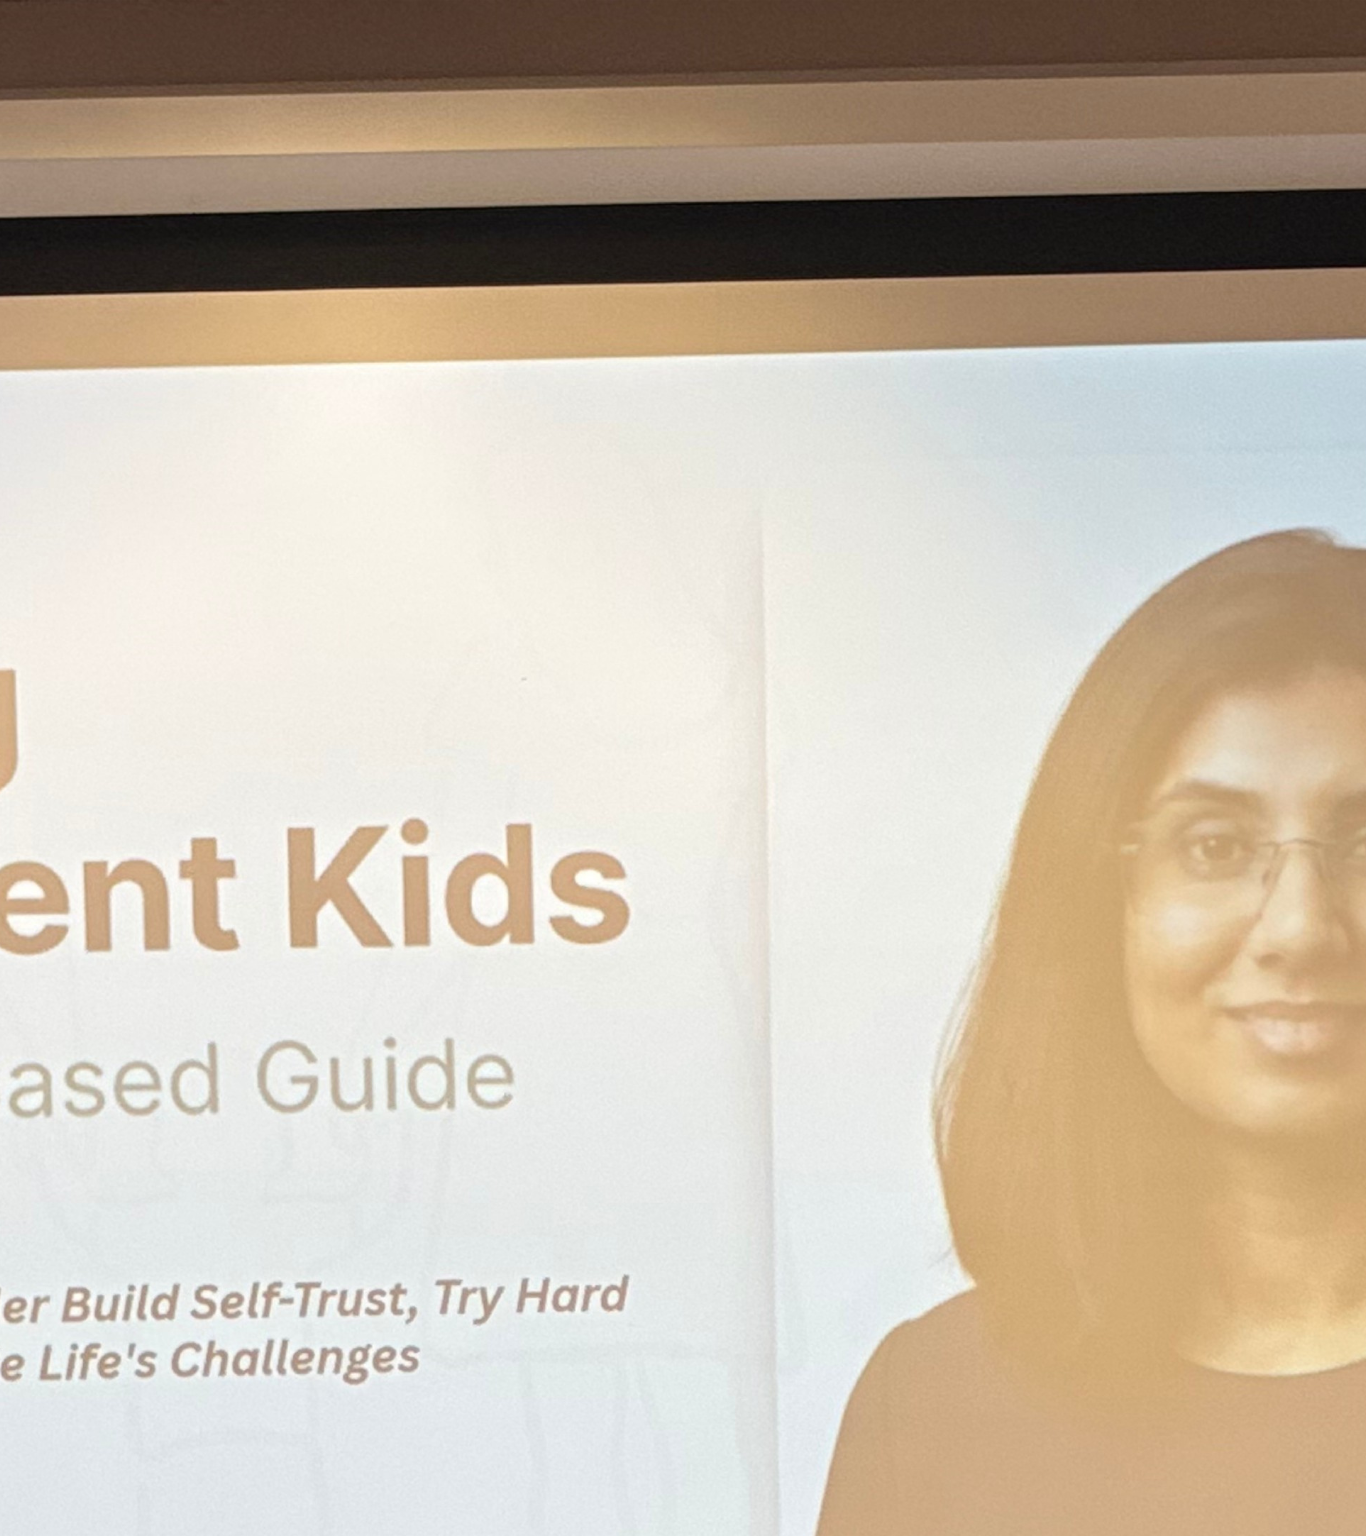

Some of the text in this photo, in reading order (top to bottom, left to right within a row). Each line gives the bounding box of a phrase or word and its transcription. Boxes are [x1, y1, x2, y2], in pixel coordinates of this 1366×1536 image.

[287, 818, 630, 948] Kids
[257, 1037, 514, 1114] Guide
[62, 1284, 180, 1322] Build
[191, 1282, 417, 1324] Self-Trust,
[435, 1279, 505, 1325] Try
[516, 1274, 629, 1313] Hard
[39, 1343, 157, 1381] Life's
[171, 1339, 420, 1385] Challenges
